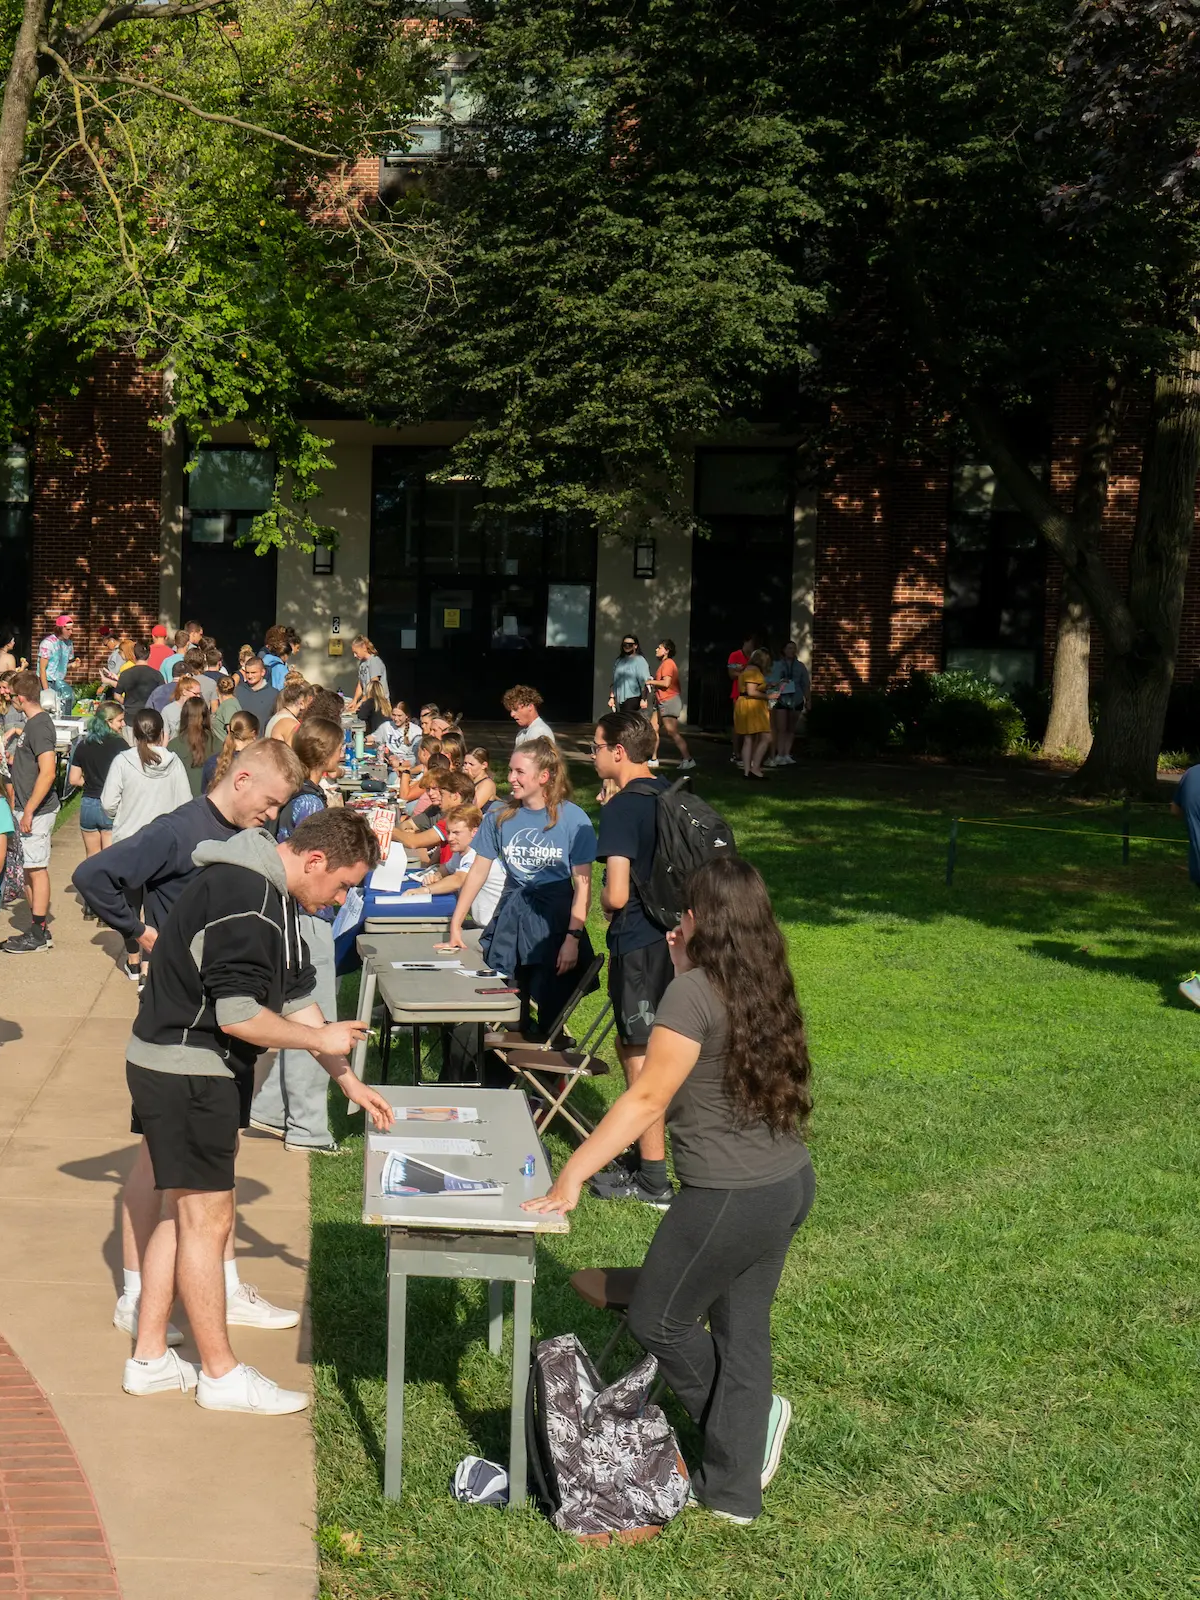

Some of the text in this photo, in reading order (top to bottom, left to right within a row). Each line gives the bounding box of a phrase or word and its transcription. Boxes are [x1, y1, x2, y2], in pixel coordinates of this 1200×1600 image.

[333, 617, 340, 633] 20
[529, 846, 563, 858] SHORE
[505, 857, 556, 867] VOLLEYBALL
